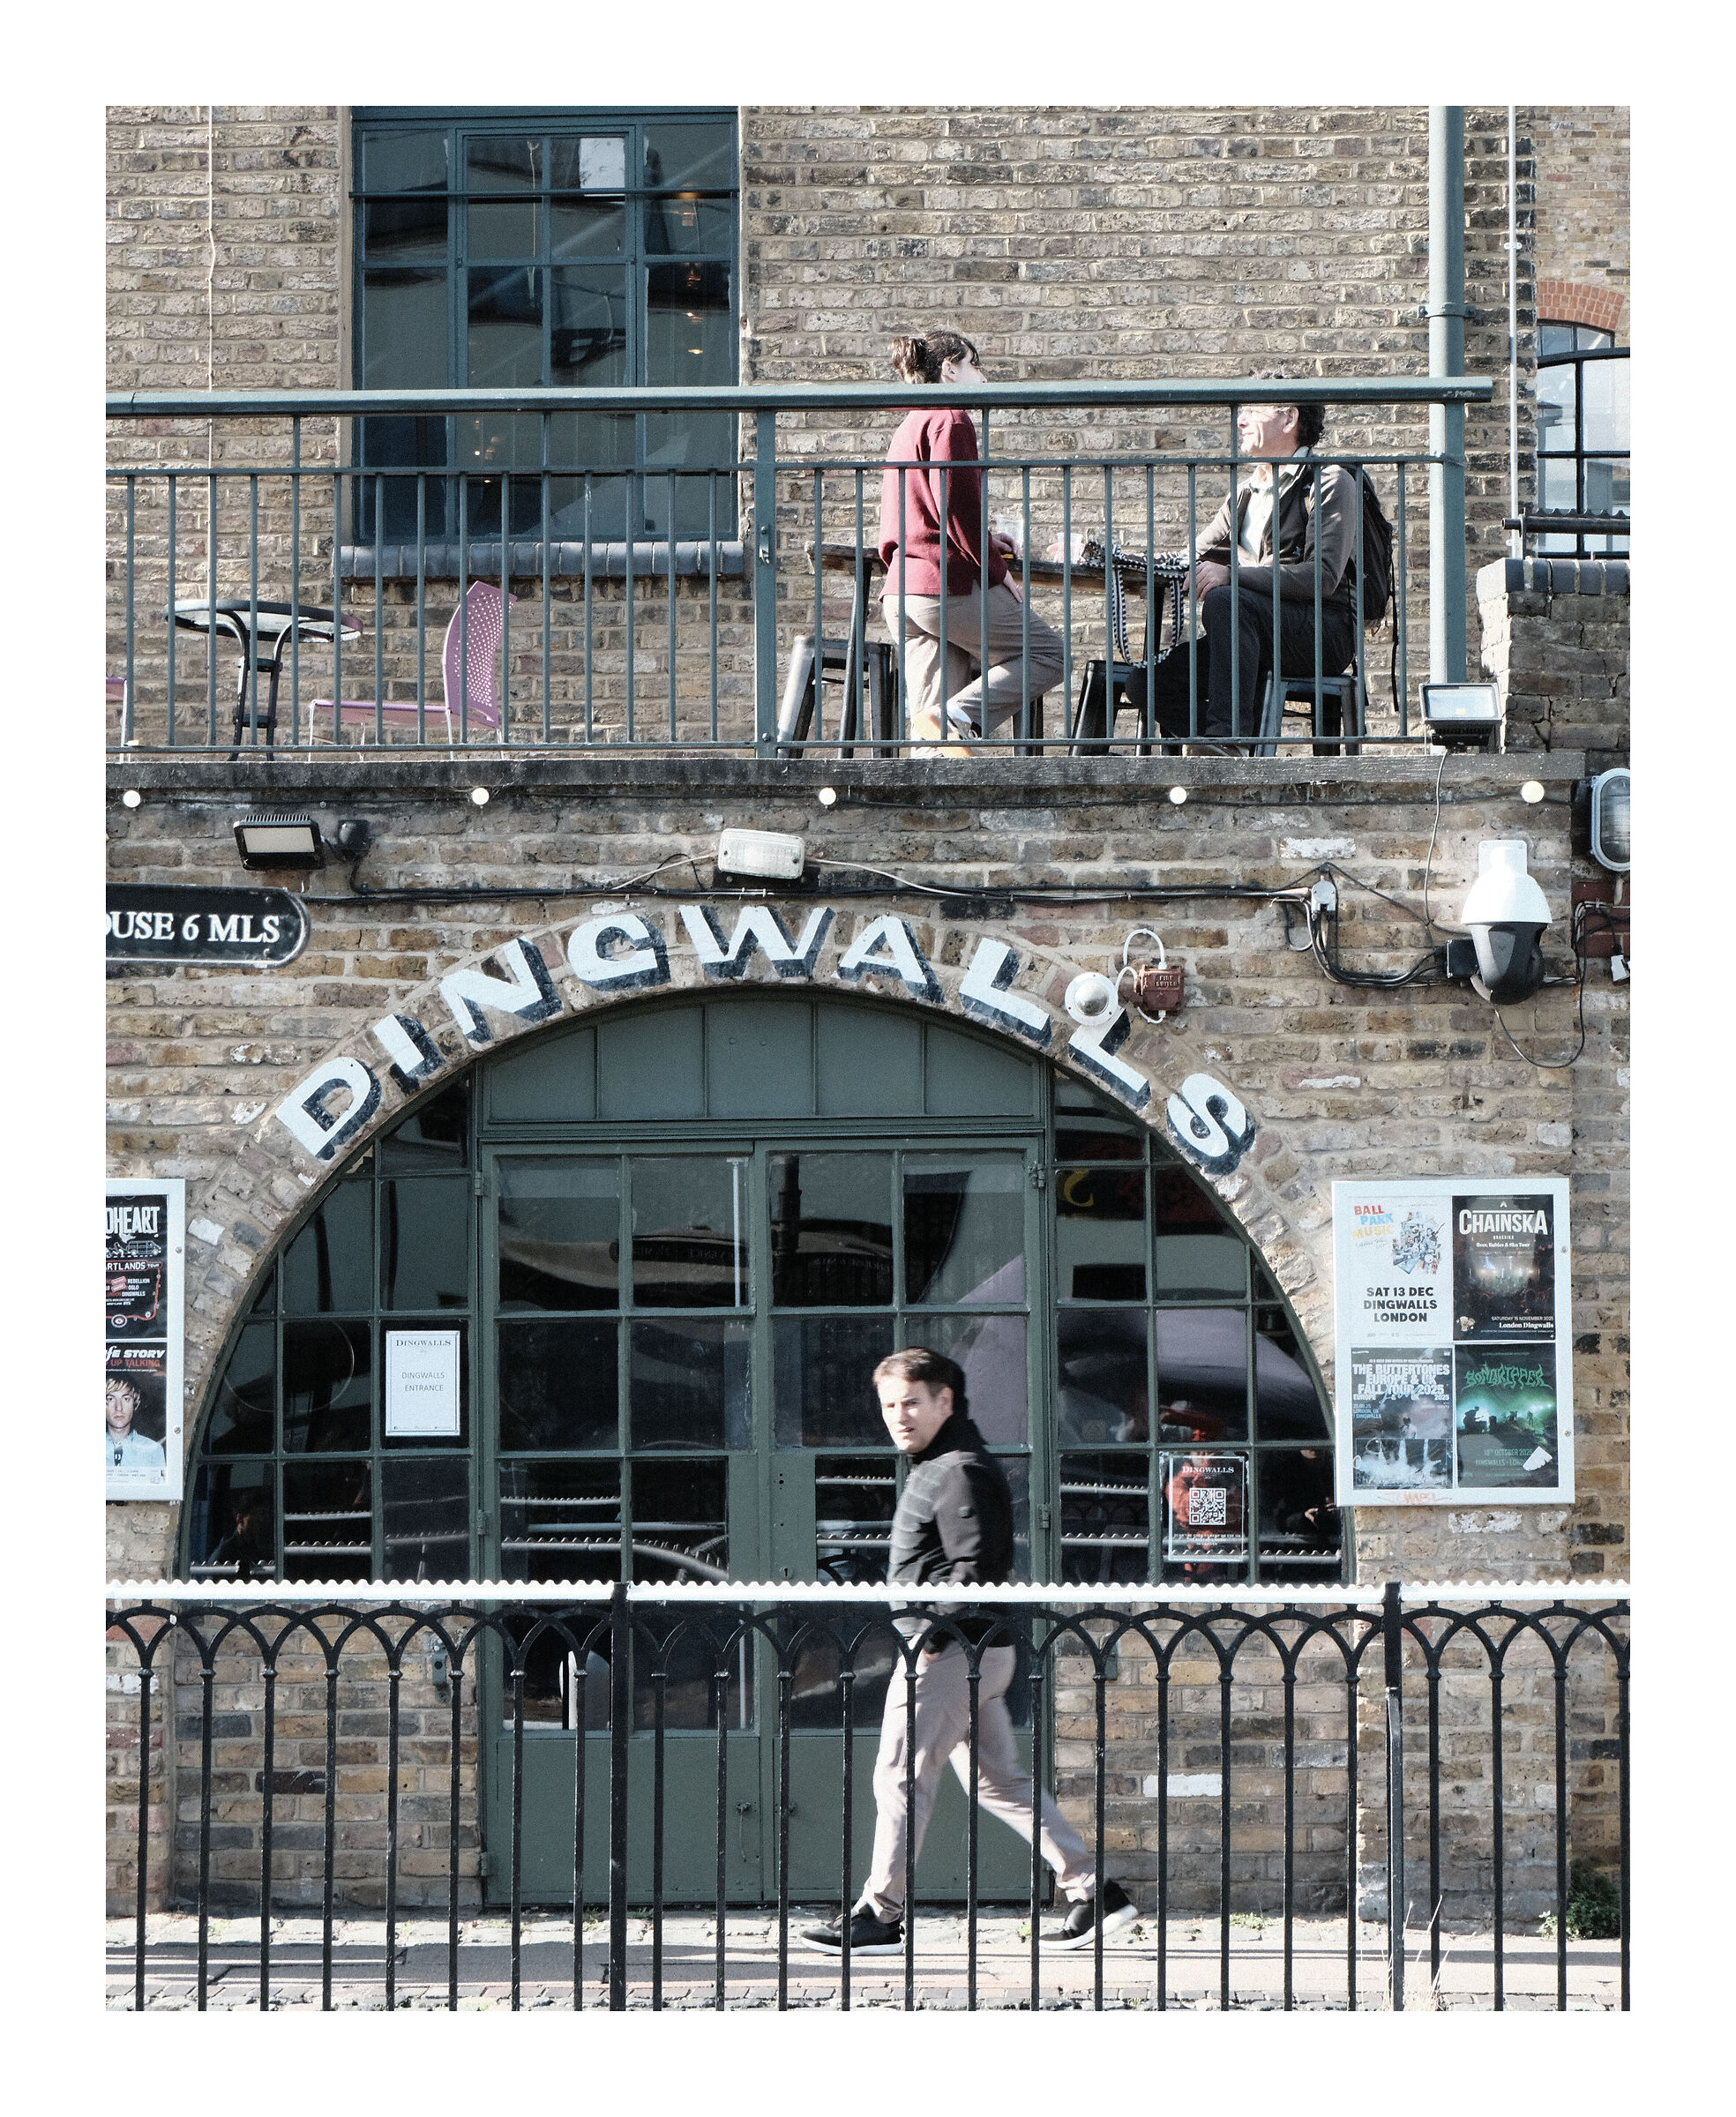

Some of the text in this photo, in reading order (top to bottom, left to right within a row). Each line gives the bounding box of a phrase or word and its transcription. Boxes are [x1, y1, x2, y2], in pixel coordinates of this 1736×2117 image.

[182, 914, 200, 941] 6
[207, 914, 281, 943] MLS
[275, 903, 1257, 1178] DINGWALLS
[1354, 1205, 1384, 1216] BALL
[1360, 1213, 1394, 1225] PARK
[1459, 1209, 1548, 1235] CHAINSKA
[1351, 1224, 1395, 1240] MUSIC
[1366, 1287, 1433, 1297] SAT 13 DEC
[1363, 1299, 1438, 1309] DINGWALLS
[1374, 1313, 1427, 1322] LONDON
[123, 1350, 166, 1358] STORY
[125, 1358, 161, 1367] TALKING
[1352, 1364, 1450, 1375] THE BUTTERTONES
[1366, 1373, 1437, 1385] EUROPE & UK
[1358, 1384, 1385, 1395] FALL
[1387, 1383, 1415, 1395] TOUR
[1417, 1384, 1445, 1395] 2025
